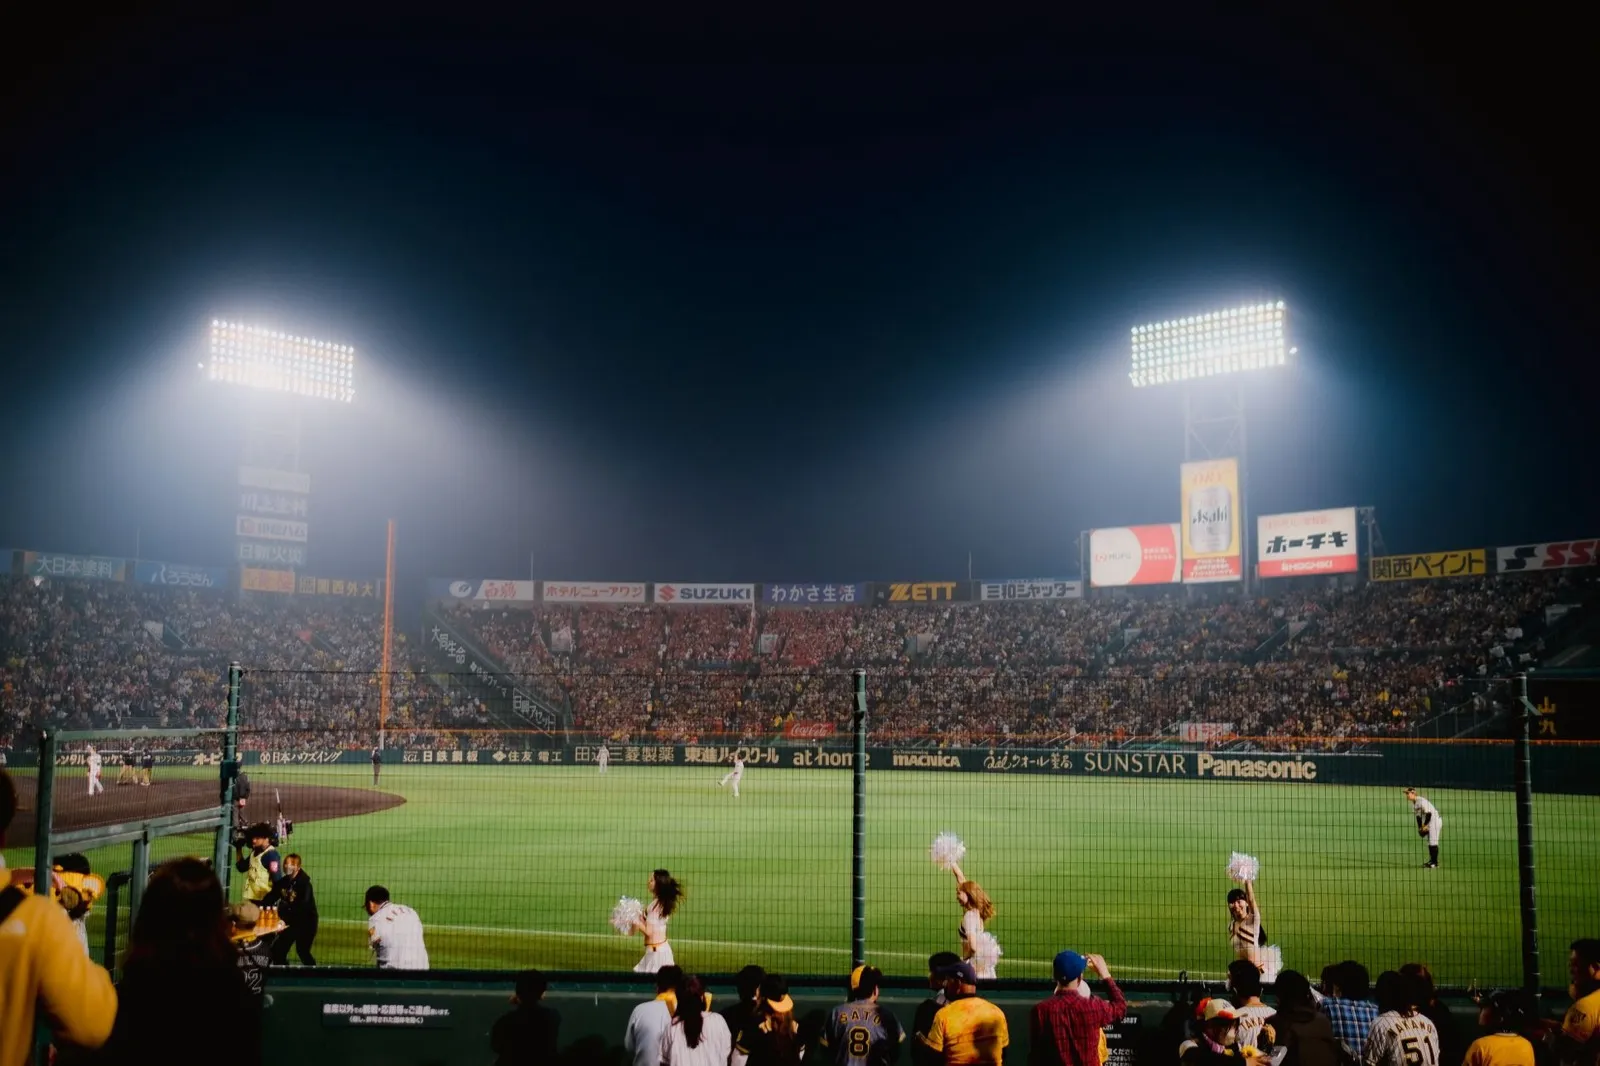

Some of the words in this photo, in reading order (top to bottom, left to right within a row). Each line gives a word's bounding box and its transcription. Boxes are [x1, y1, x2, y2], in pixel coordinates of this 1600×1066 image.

[1192, 505, 1228, 525] Asahi
[1266, 531, 1349, 554] ホーチキ
[37, 556, 112, 578] 大日本塗料
[1372, 552, 1485, 579] 関西ペイント
[545, 585, 643, 598] ホテルニューアワジ
[679, 585, 750, 600] SUZUKI
[771, 584, 856, 602] わかさ生活
[888, 582, 957, 601] ZETT
[1537, 696, 1556, 735] 山九
[272, 750, 343, 764] 日本ハウズイング
[508, 751, 562, 763] 住友電工
[1084, 752, 1185, 774] SUNSTAR
[1198, 754, 1317, 779] Panasonic
[840, 1010, 881, 1025] SATO
[849, 1026, 870, 1058] 8
[1401, 1036, 1436, 1066] 51
